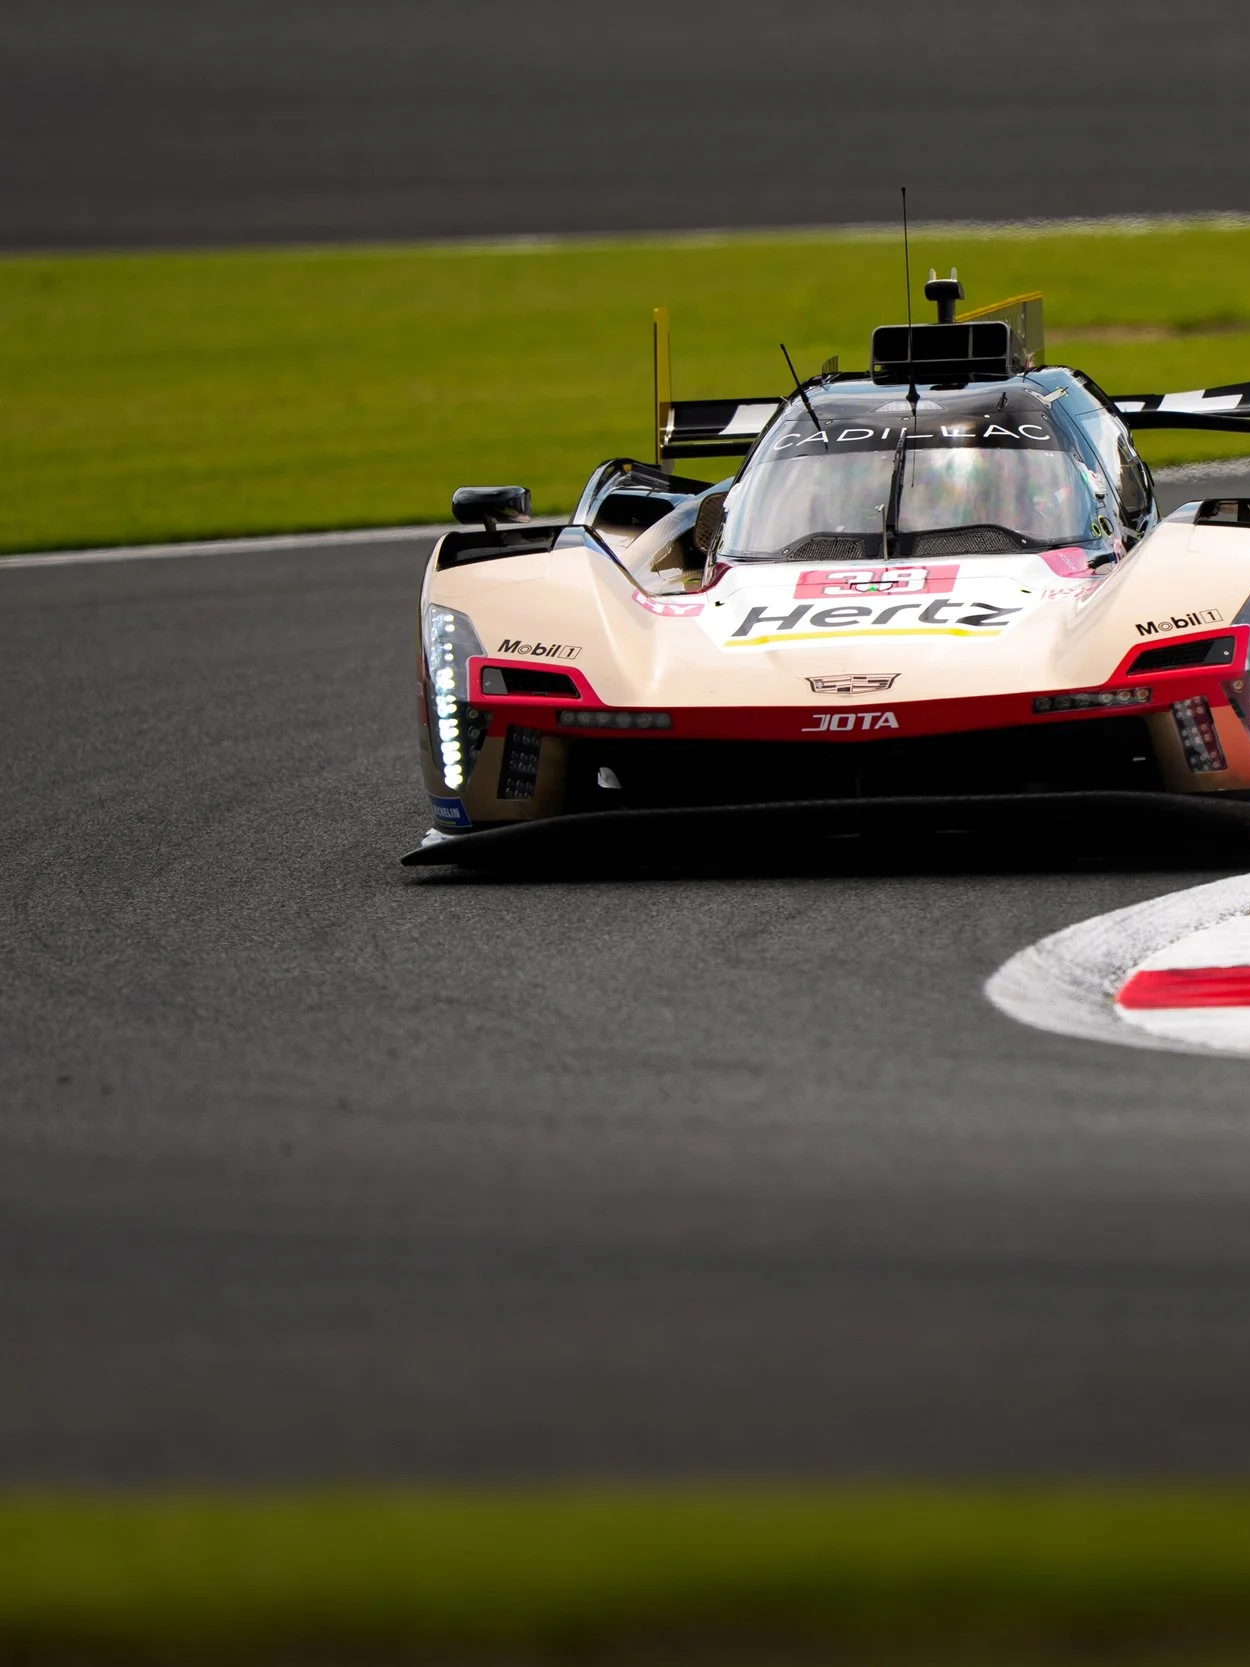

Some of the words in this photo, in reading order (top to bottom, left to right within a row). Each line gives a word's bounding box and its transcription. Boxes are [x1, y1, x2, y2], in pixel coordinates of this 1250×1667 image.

[773, 424, 1050, 451] CADILLAC
[822, 568, 928, 595] 38
[635, 591, 699, 615] HY
[731, 599, 1023, 637] Hertz
[1135, 612, 1201, 636] Mobil
[497, 639, 561, 657] Mobil
[801, 711, 899, 732] JOTA
